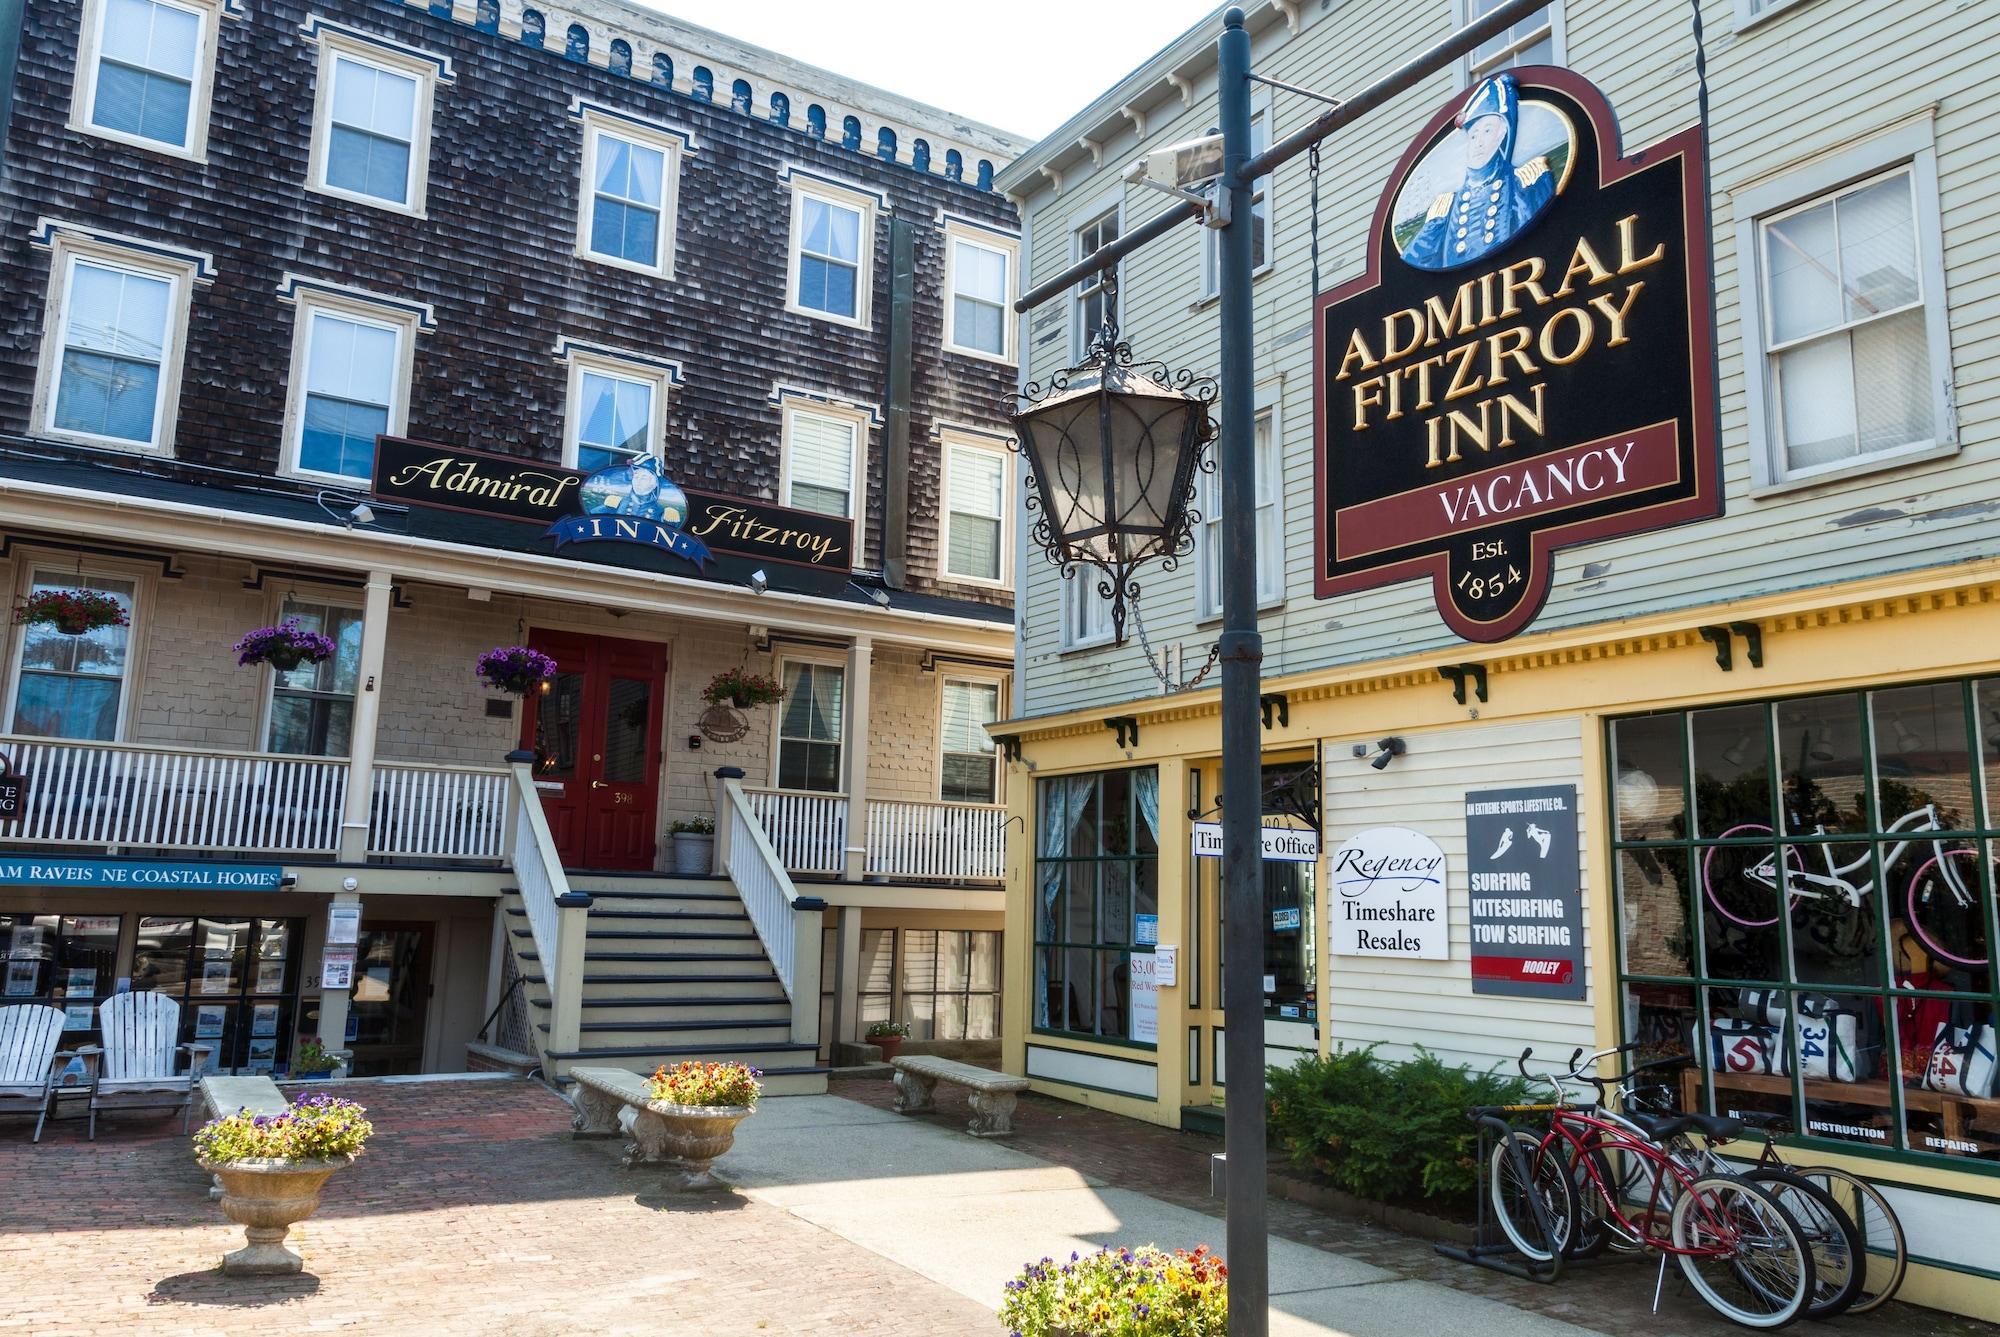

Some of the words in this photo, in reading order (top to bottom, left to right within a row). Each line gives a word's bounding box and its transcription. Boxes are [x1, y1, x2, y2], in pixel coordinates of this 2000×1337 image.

[1335, 214, 1665, 381] ADMIRAL
[1352, 280, 1646, 432] FITZROY
[1425, 382, 1548, 469] INN
[1439, 442, 1634, 524] VACANCY
[390, 457, 580, 509] Admiral
[691, 504, 842, 563] Fitzroy
[591, 518, 679, 550] INN
[1472, 539, 1508, 561] Est.
[1457, 564, 1522, 599] 1854
[1475, 802, 1500, 815] EXTREME
[1501, 800, 1523, 814] SPORTS
[1524, 798, 1553, 812] LIFESTYLE
[1275, 836, 1315, 855] Office
[30, 866, 93, 880] RAVEIS
[102, 869, 128, 882] NE
[131, 869, 213, 884] COASTAL
[216, 872, 278, 886] HOMES
[1335, 848, 1442, 898] Regency
[1471, 872, 1531, 892] SURFING
[1342, 900, 1436, 922] Timeshare
[1472, 899, 1564, 919] KITESURFING
[1357, 929, 1421, 951] Resales
[1473, 924, 1505, 944] TOW
[1508, 925, 1571, 946] SURFING
[1522, 961, 1560, 975] HOOLEY
[1145, 981, 1158, 992] Wee
[1727, 1036, 1761, 1072] 5
[1809, 1120, 1885, 1140] INSTRUCTION
[1925, 1136, 1978, 1153] REPAIRS
